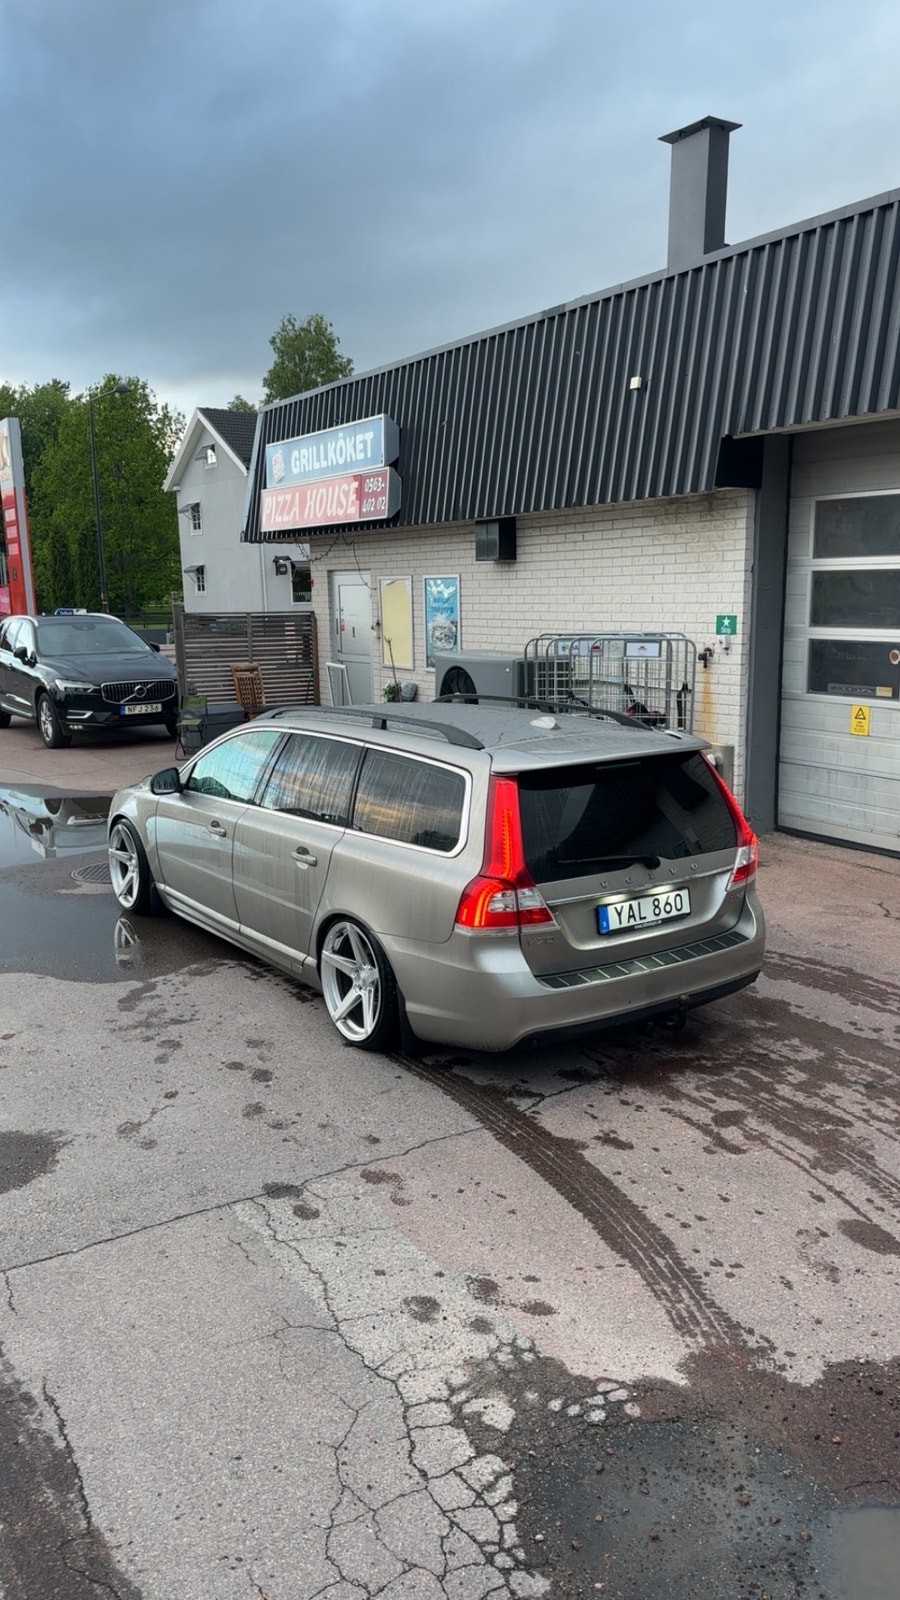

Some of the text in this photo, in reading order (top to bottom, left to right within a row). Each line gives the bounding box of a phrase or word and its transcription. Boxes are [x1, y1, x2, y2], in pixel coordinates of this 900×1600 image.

[290, 431, 374, 474] GRILLKÖKET
[364, 476, 385, 493] 0563-
[262, 481, 359, 524] PIZZA HOUSE
[127, 705, 143, 714] NFJ
[614, 901, 647, 925] YAL
[652, 893, 683, 917] 860
